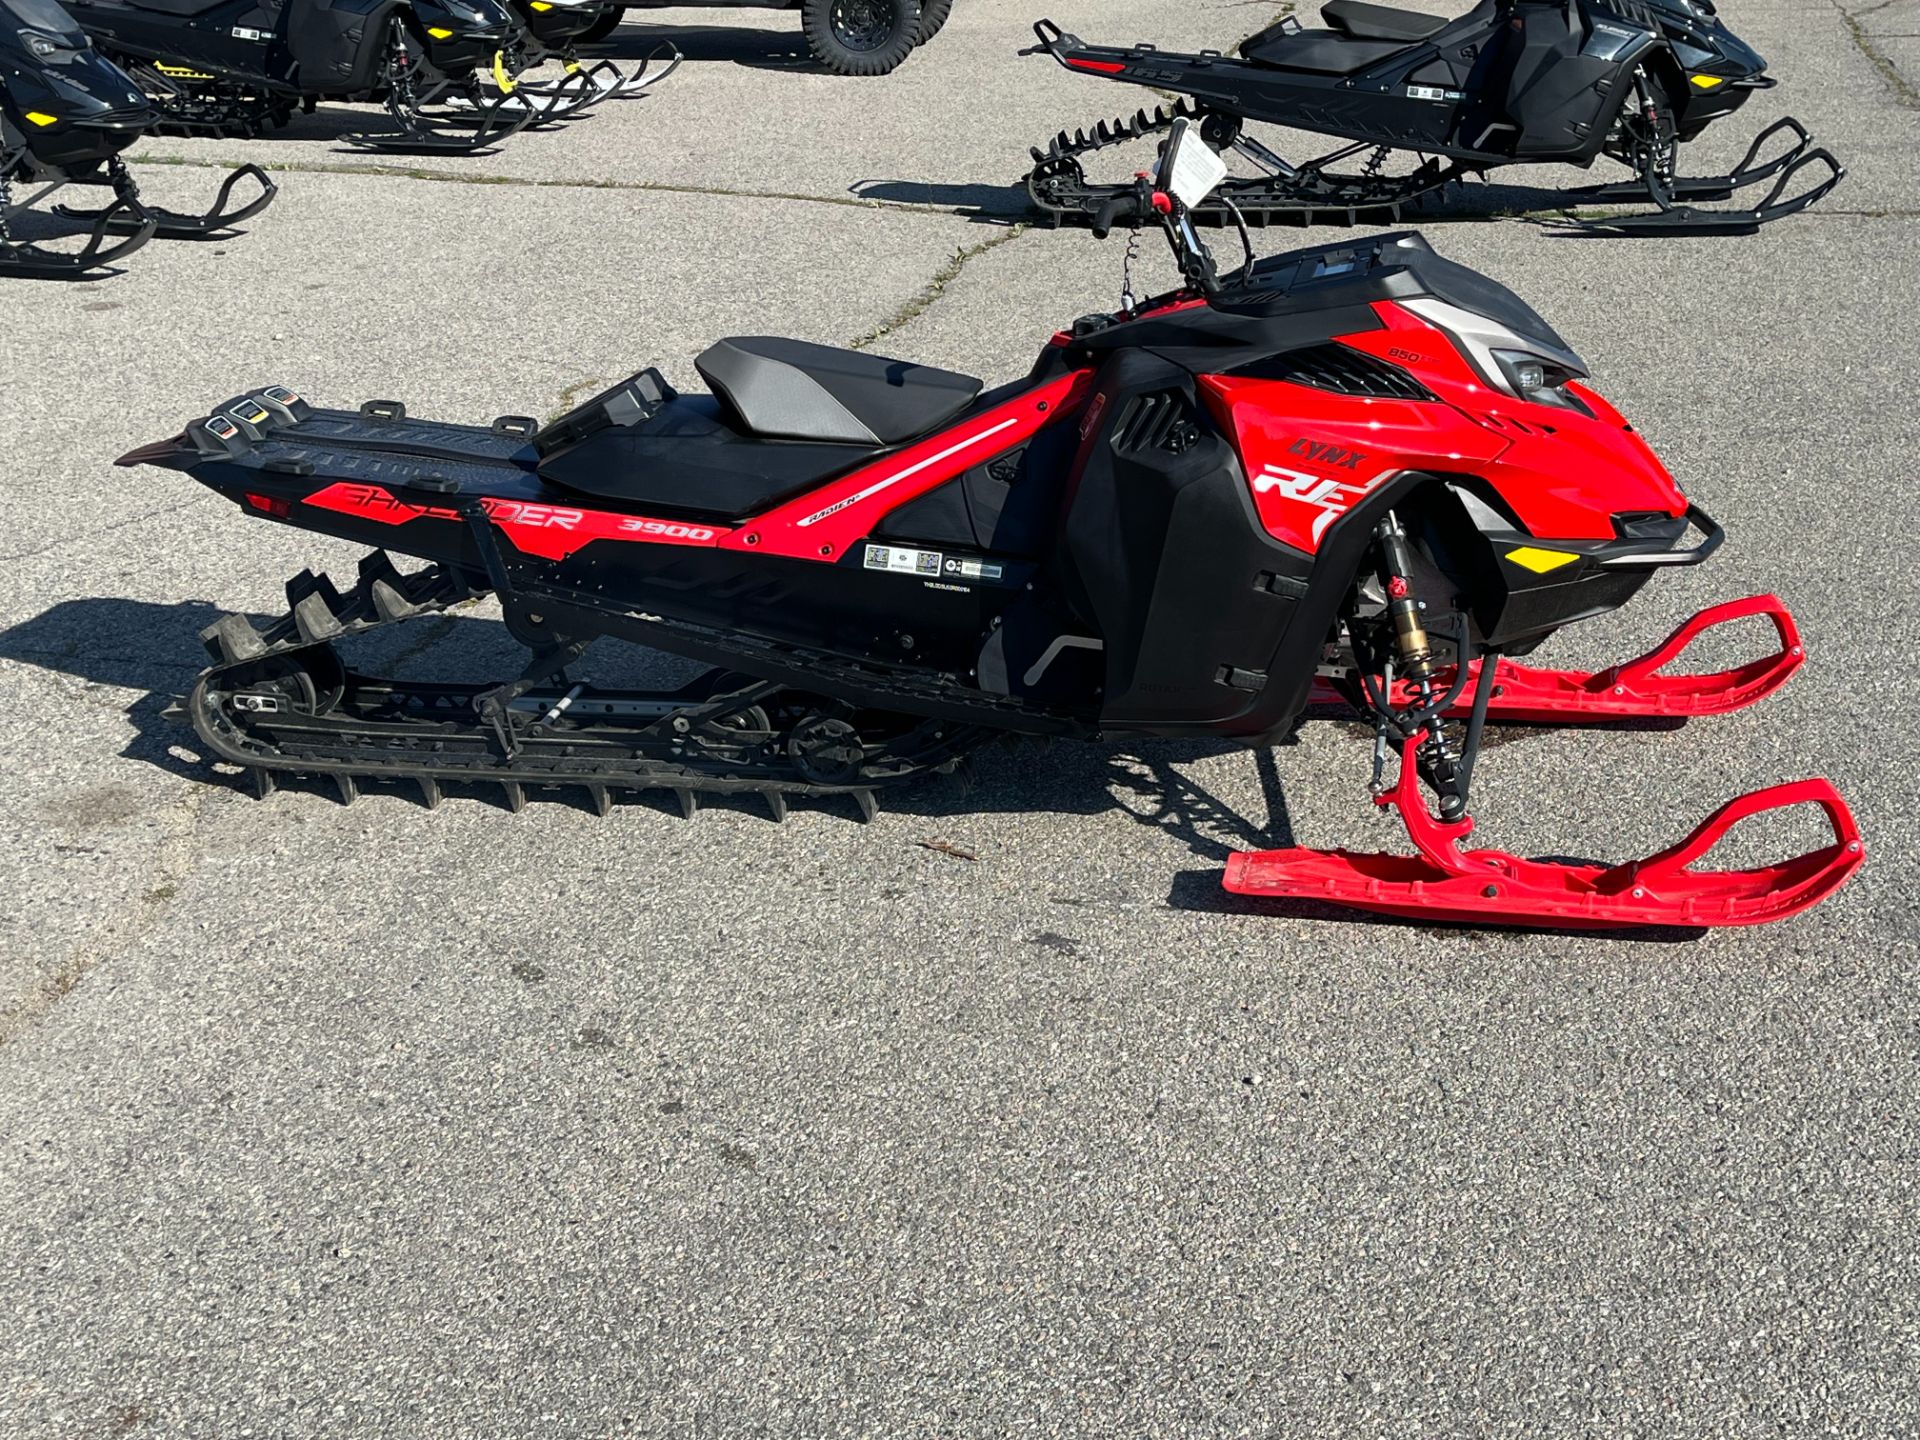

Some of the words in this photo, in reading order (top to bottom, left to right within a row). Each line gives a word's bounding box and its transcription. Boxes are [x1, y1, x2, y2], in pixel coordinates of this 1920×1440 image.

[1388, 347, 1420, 363] 850
[1287, 437, 1367, 470] LYNX
[617, 518, 714, 541] 3900
